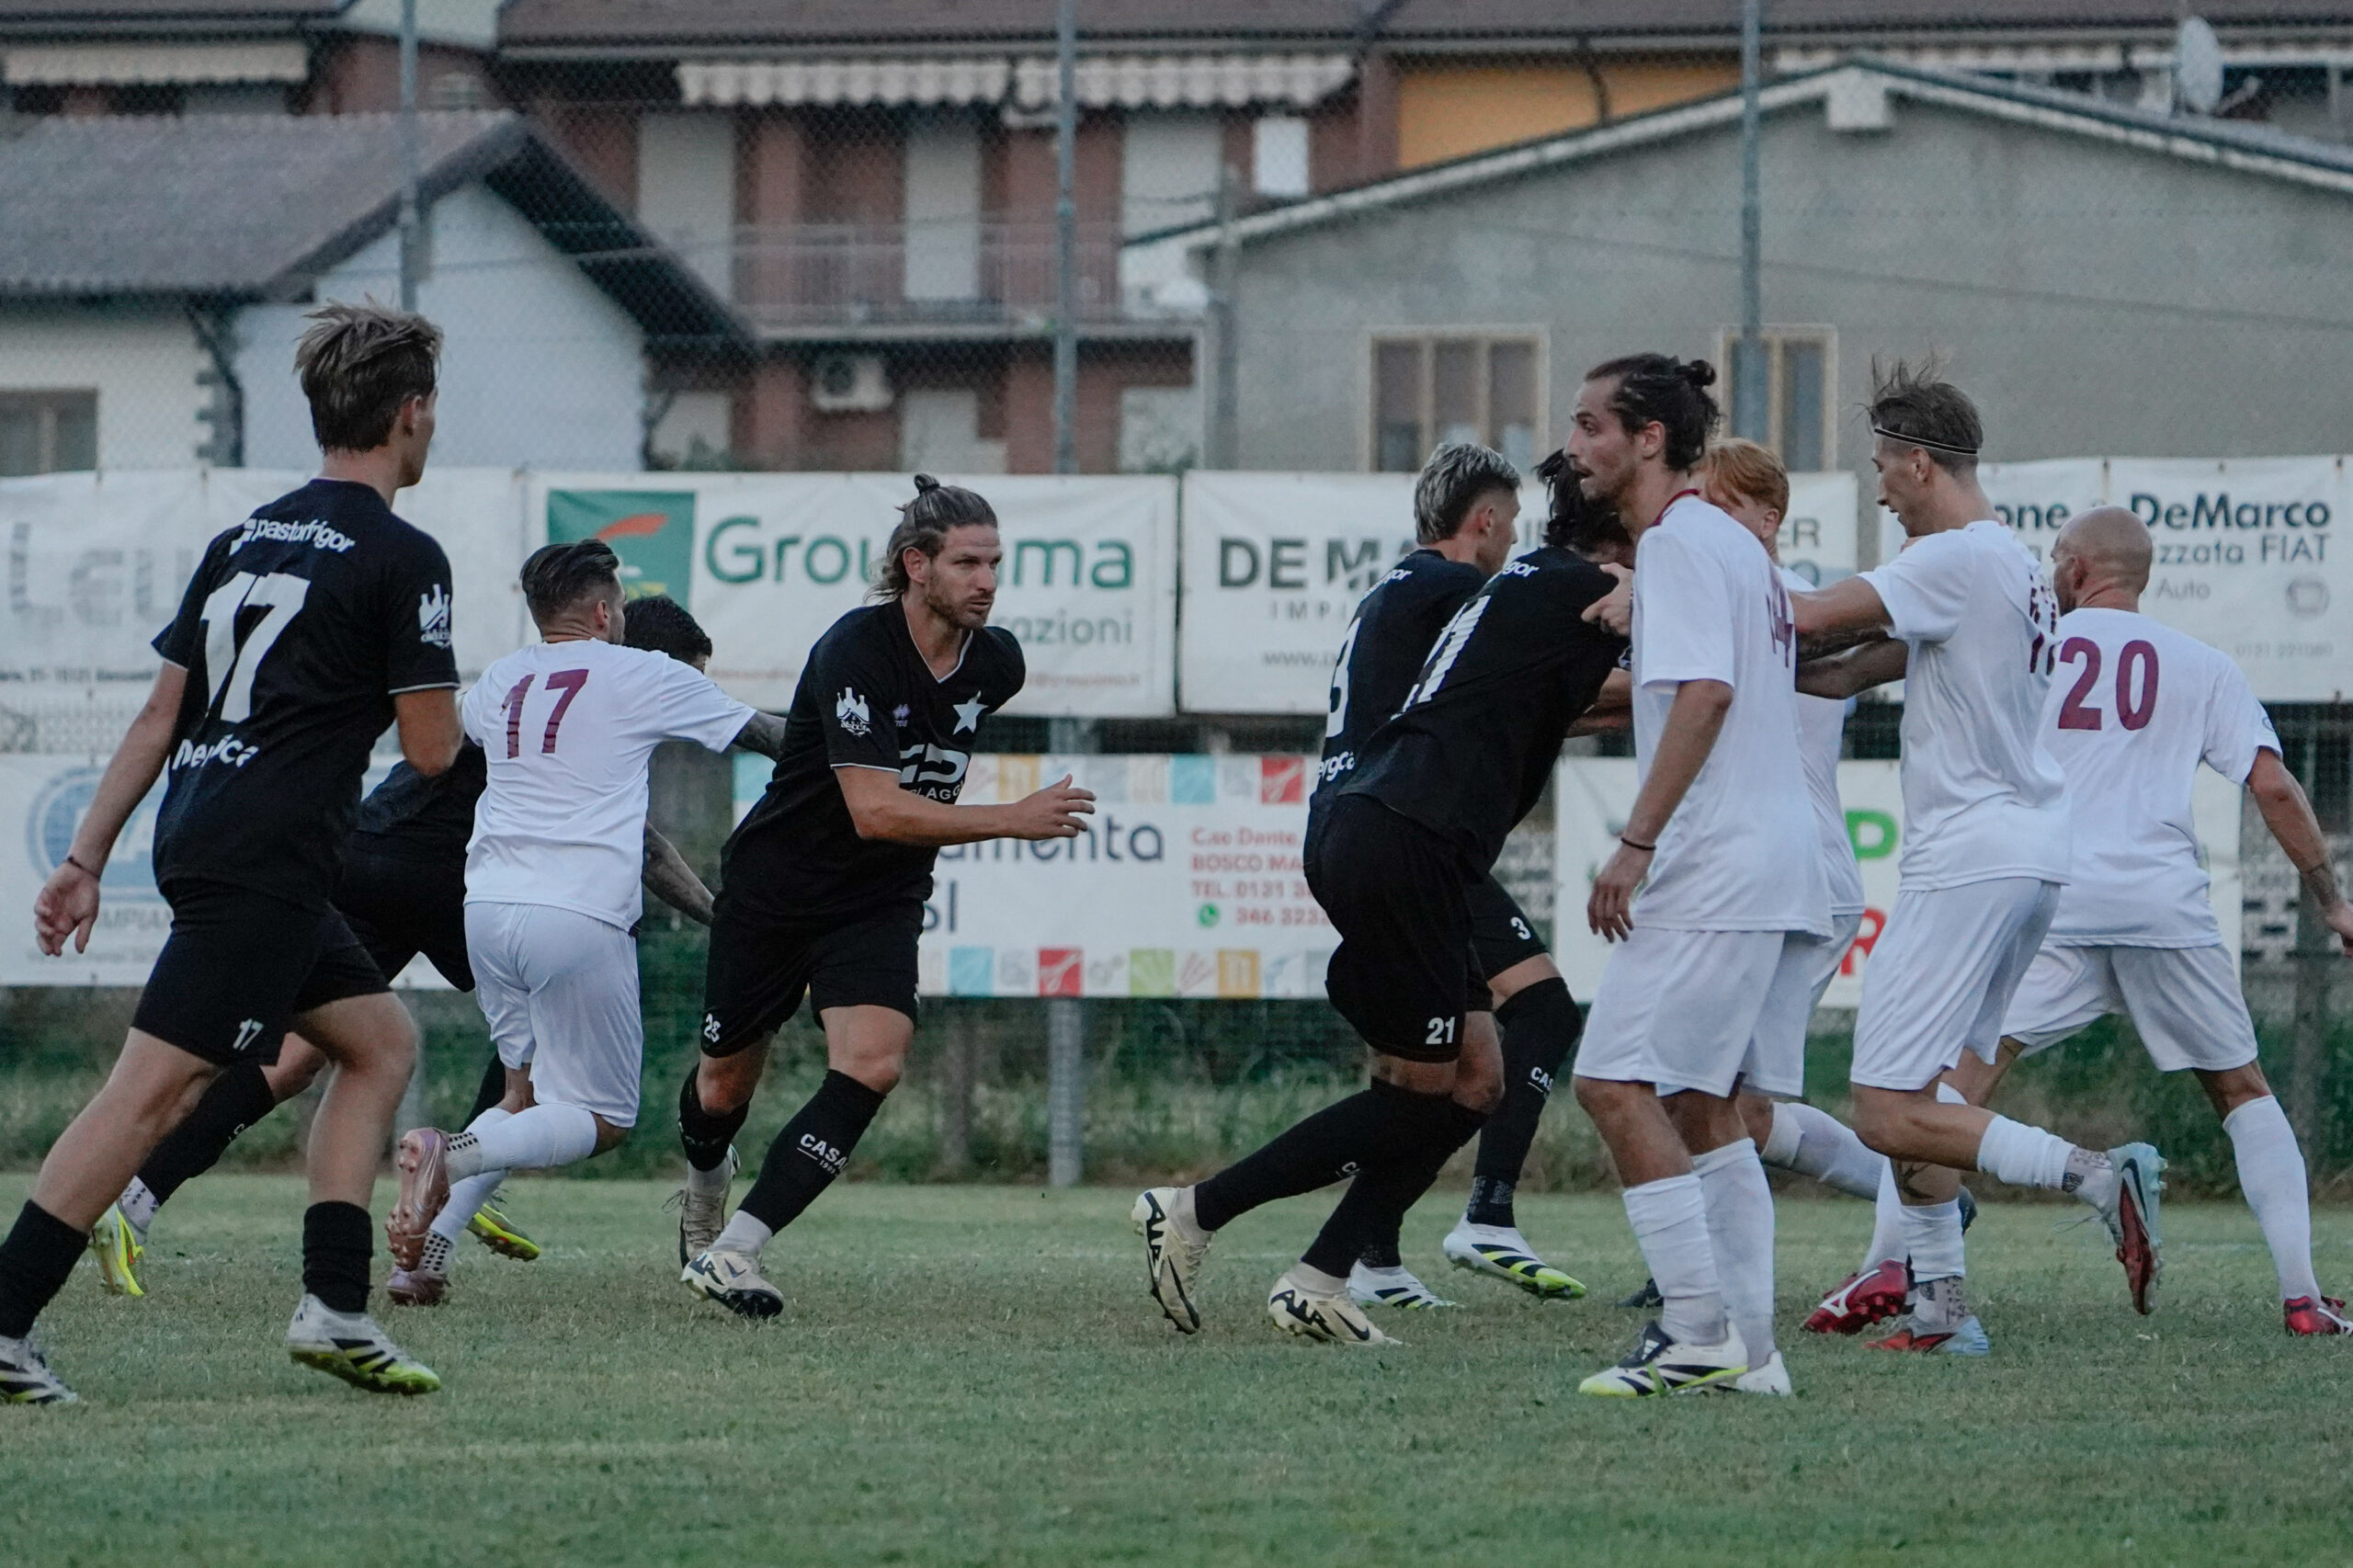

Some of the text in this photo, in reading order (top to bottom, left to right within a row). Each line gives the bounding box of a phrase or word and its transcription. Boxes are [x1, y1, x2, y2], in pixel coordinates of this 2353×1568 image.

[2130, 492, 2330, 530] DeMarco
[1219, 537, 1308, 589] DE
[2260, 533, 2331, 562] FIAT
[199, 571, 312, 723] 17
[2059, 636, 2160, 732] 20
[500, 669, 589, 760] 17
[1192, 854, 1304, 872] BOSCO MA
[1510, 915, 1532, 941] 3
[232, 1017, 265, 1051] 17
[1426, 1016, 1456, 1045] 21
[1530, 1066, 1554, 1092] CAS
[800, 1133, 849, 1172] CASA
